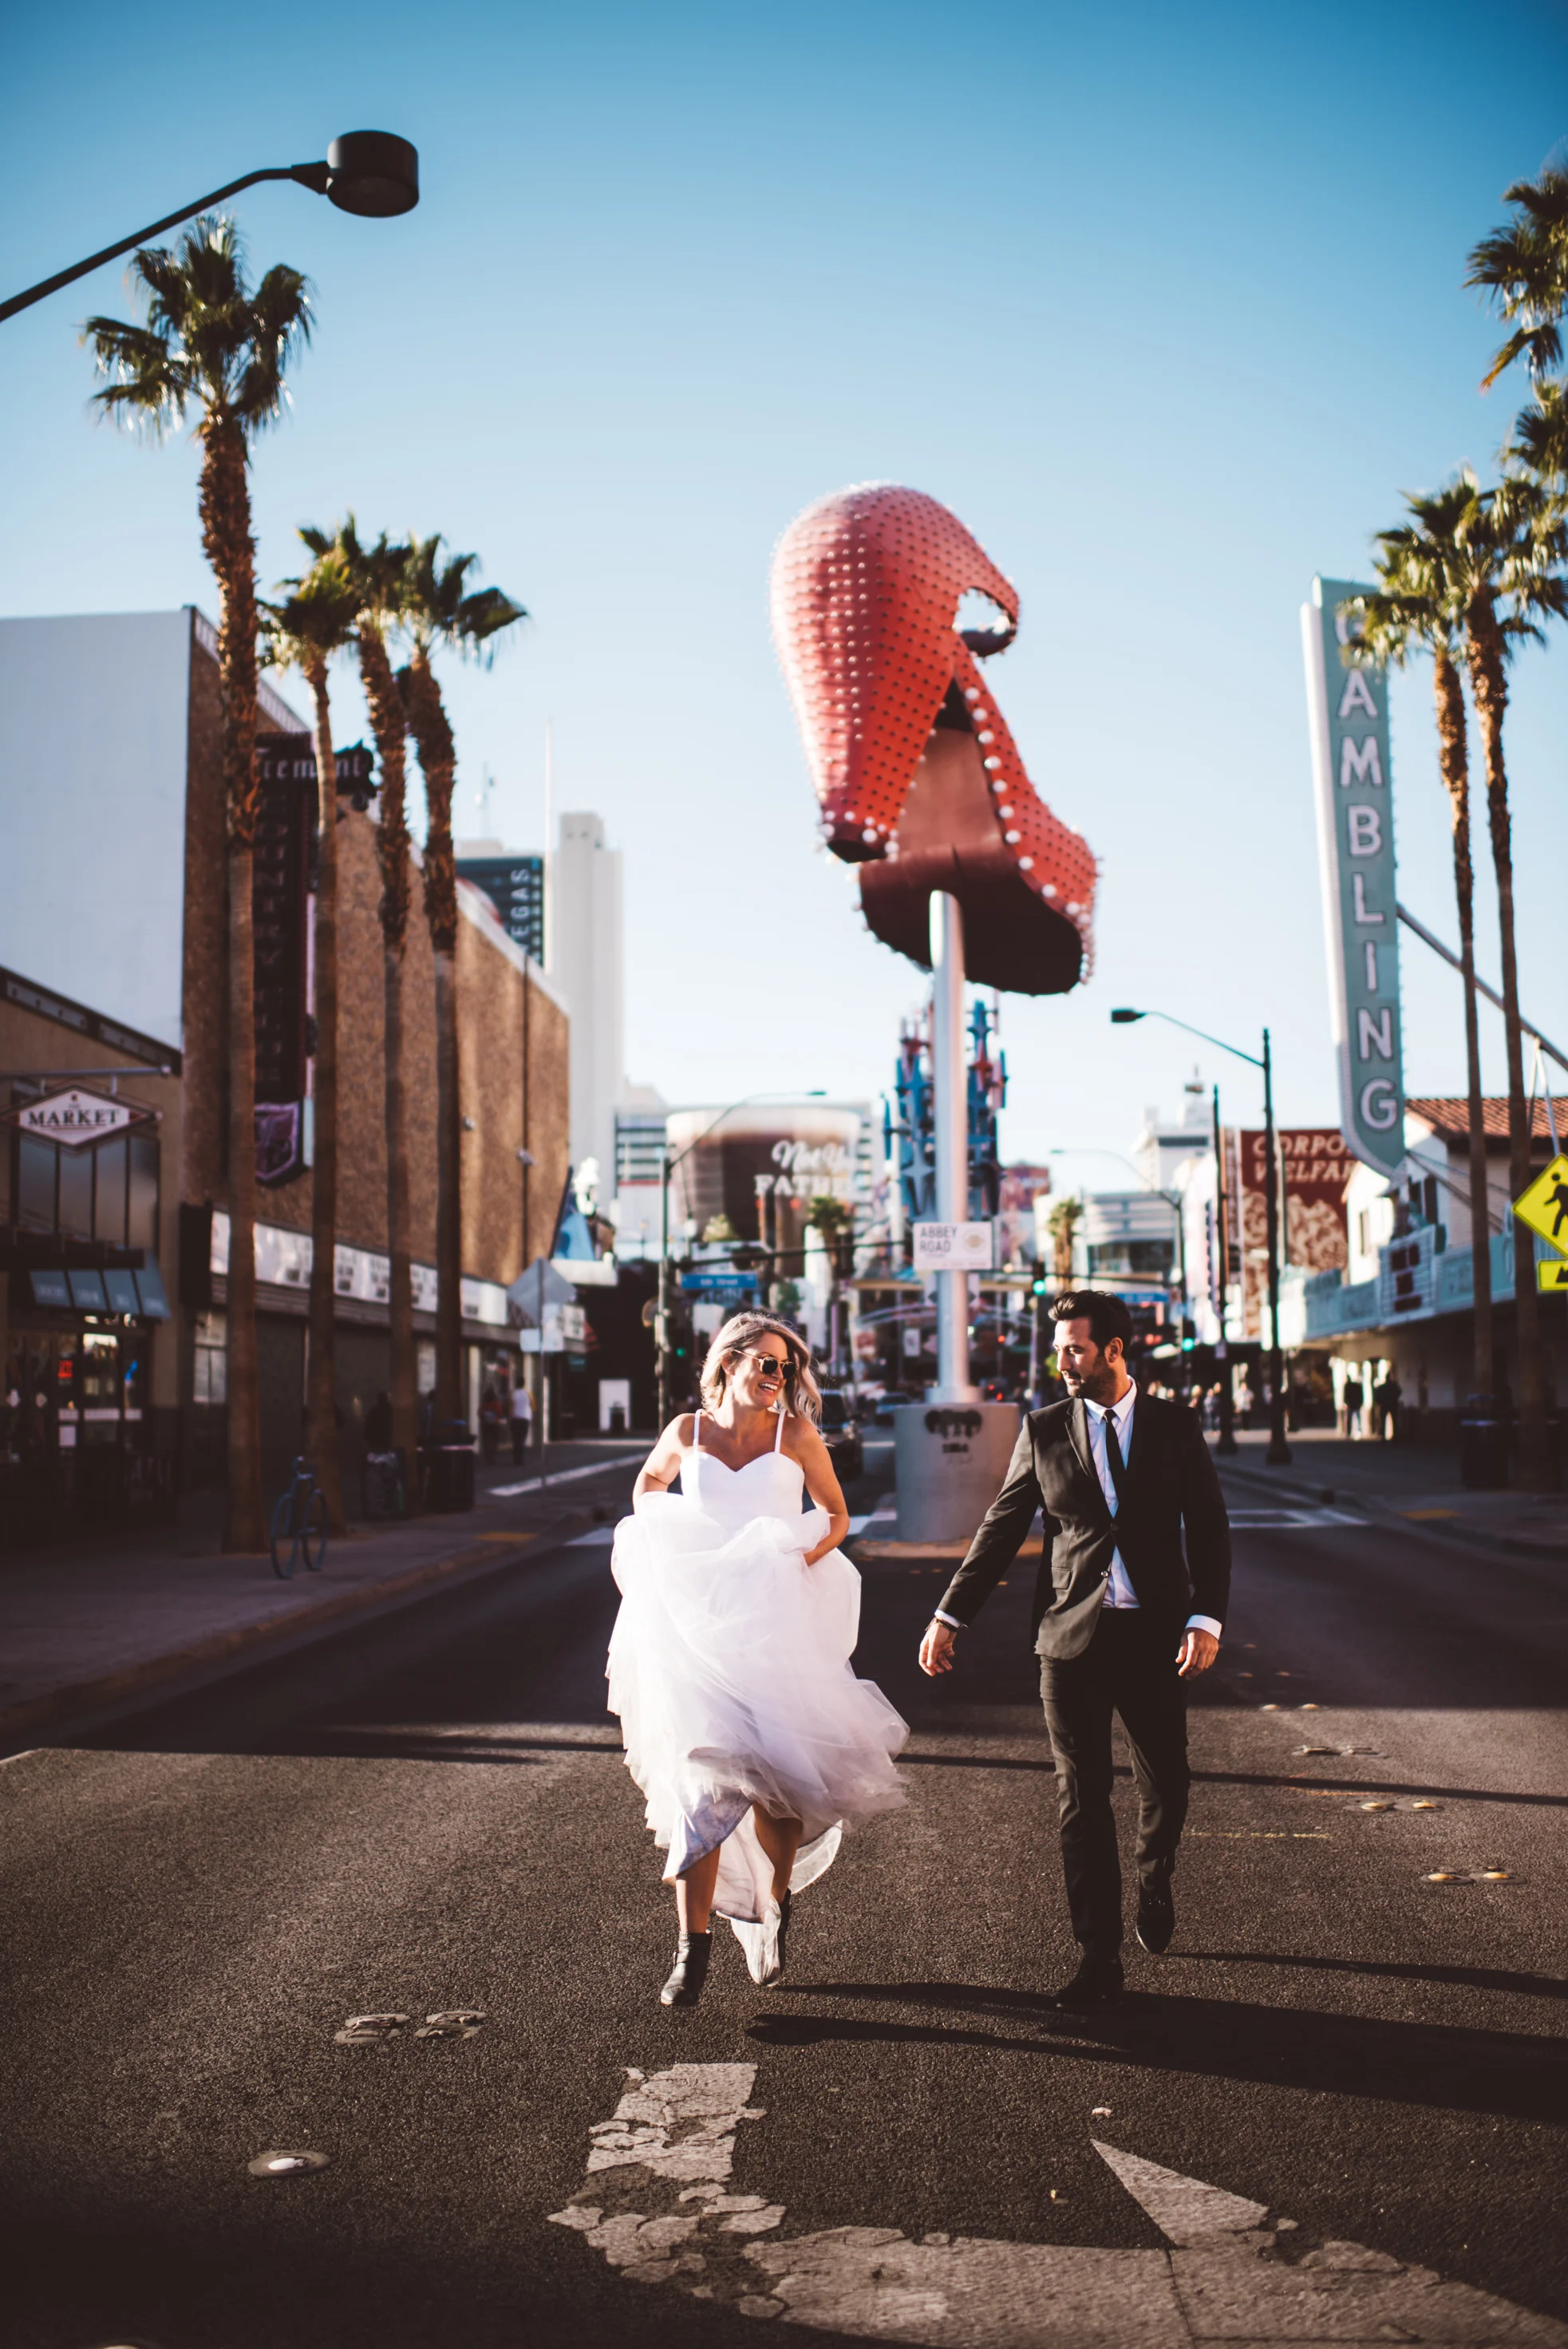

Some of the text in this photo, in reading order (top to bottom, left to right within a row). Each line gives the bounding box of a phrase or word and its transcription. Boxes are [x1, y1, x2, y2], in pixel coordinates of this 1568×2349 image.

[28, 1109, 118, 1127] MARKET
[1252, 1135, 1352, 1157] CORPO
[920, 1226, 957, 1238] ABBEY
[919, 1240, 951, 1253] ROAD
